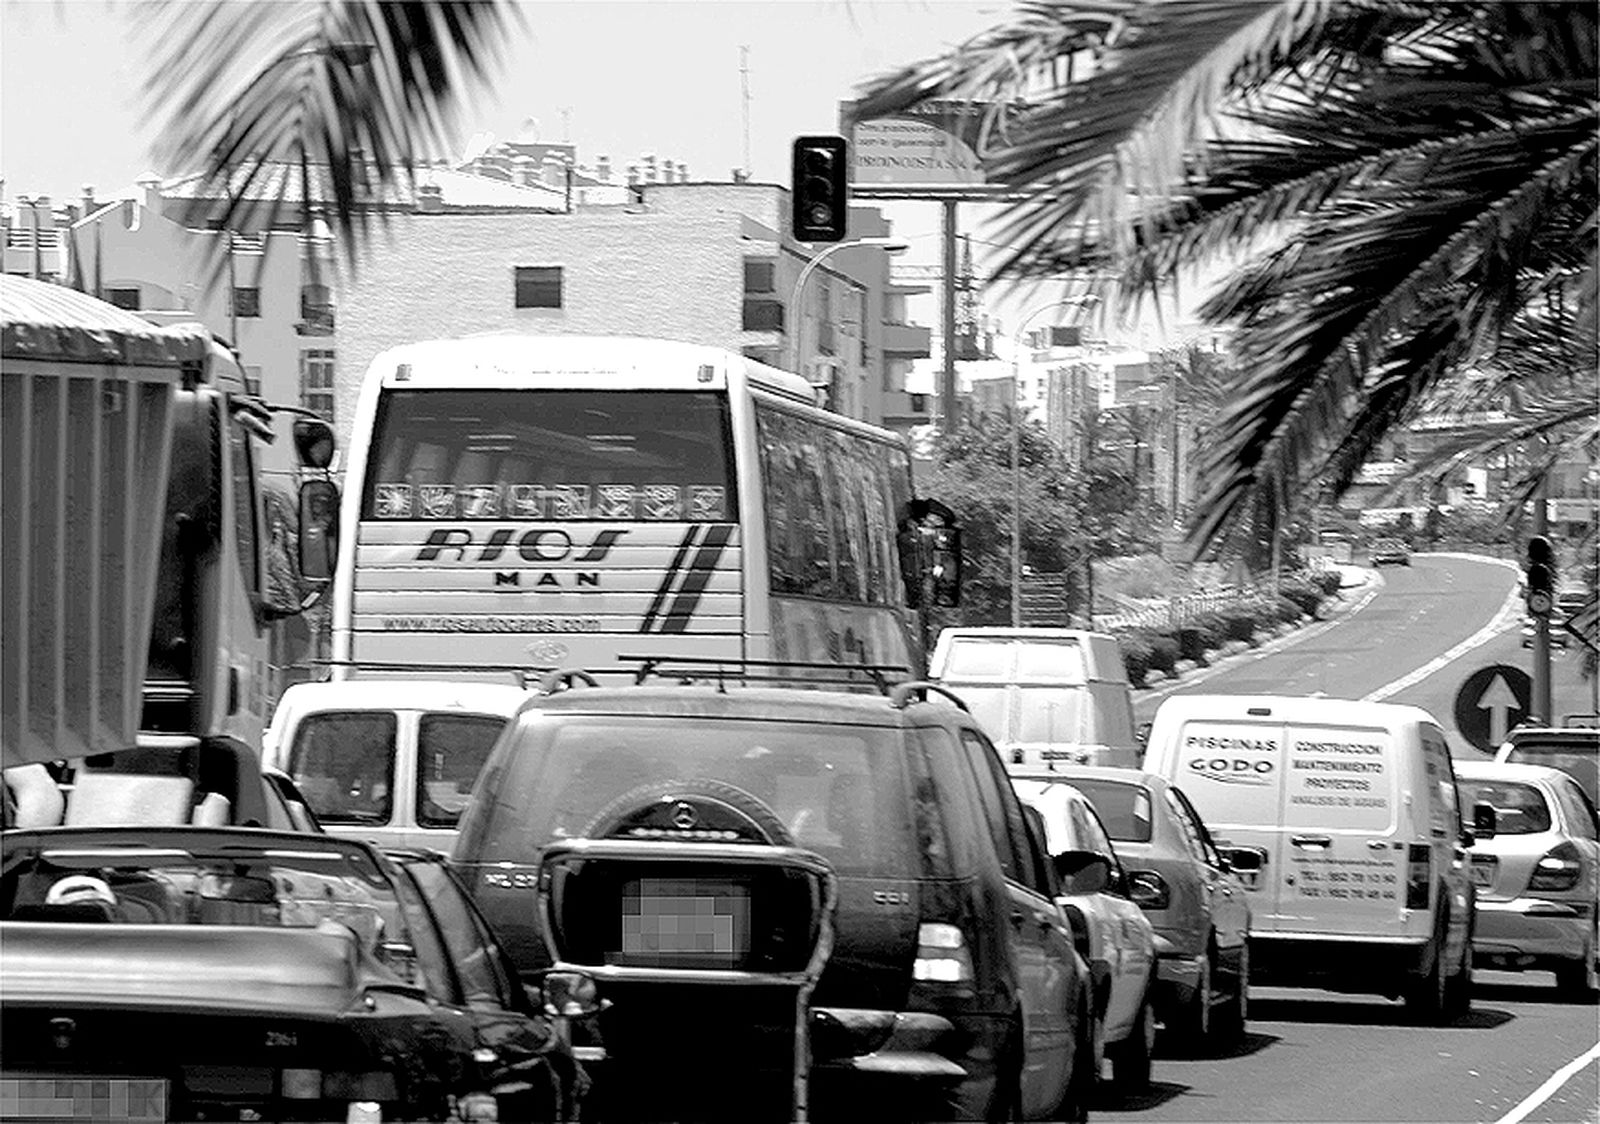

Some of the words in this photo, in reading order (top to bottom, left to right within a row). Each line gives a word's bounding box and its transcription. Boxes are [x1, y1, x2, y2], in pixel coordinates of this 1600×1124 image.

[416, 529, 629, 562] RIOS
[495, 571, 600, 587] MAN
[1185, 736, 1279, 753] PISCINAS
[1188, 758, 1275, 774] GODO
[1292, 759, 1385, 775] MANTENIMIENTO
[1303, 777, 1372, 792] PROYECTOS
